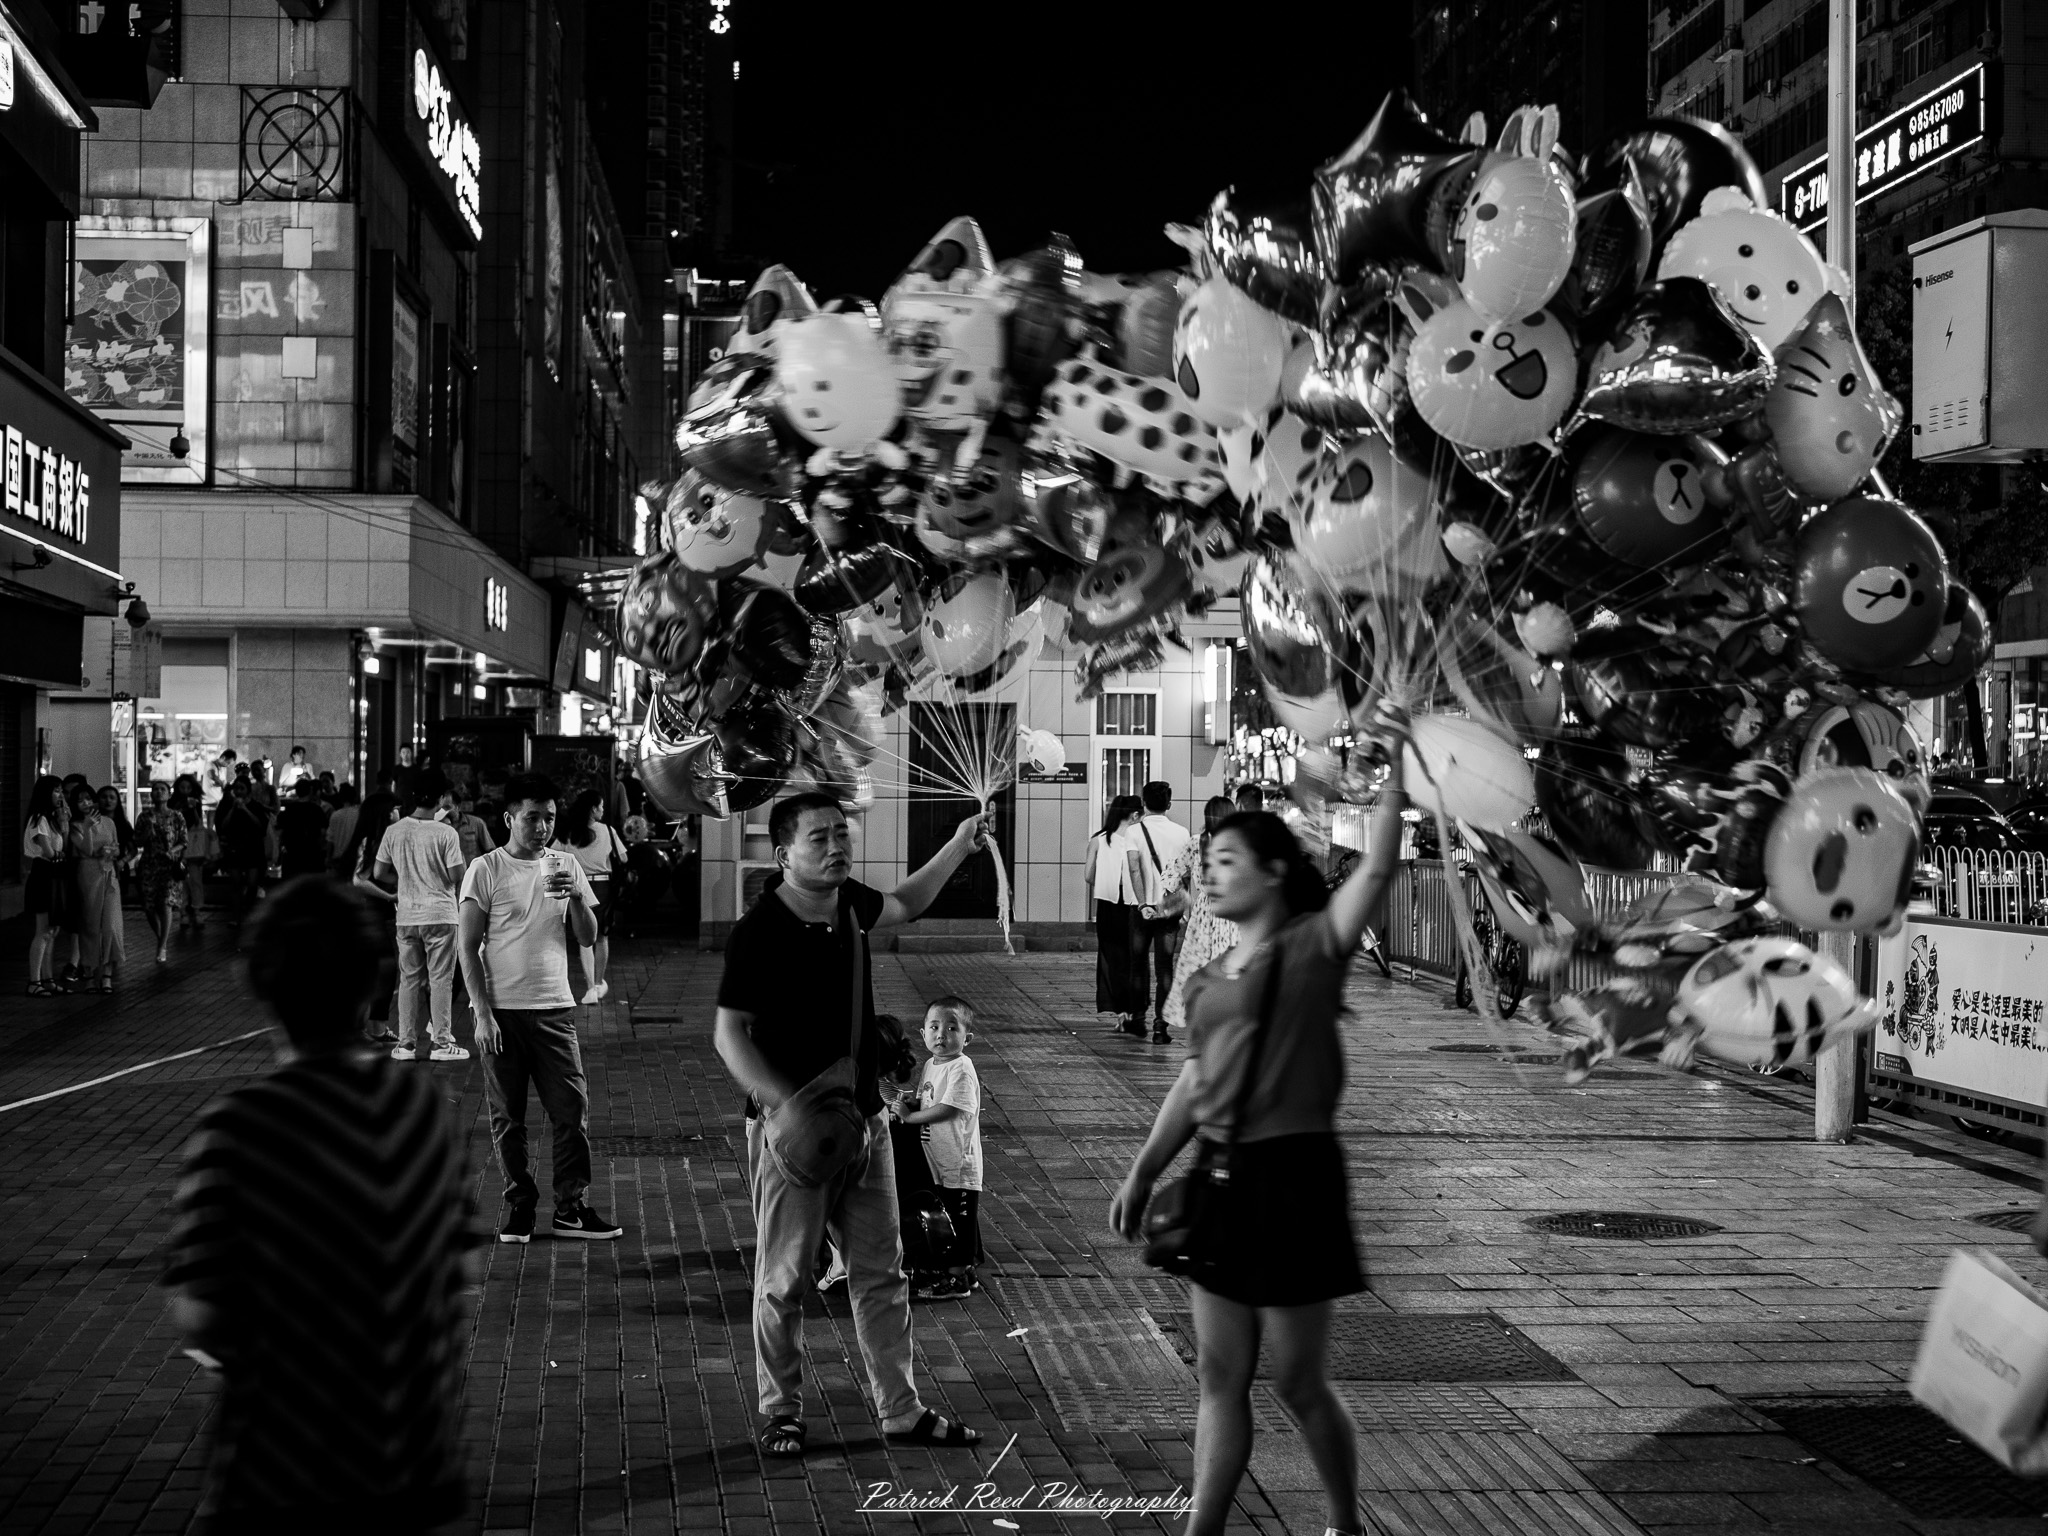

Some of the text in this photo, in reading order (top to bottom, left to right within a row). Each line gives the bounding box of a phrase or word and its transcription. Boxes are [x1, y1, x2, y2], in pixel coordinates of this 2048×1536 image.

[1917, 89, 1964, 132] 85457080
[1925, 270, 1953, 287] Hisense
[0, 424, 89, 545] 国工商银行
